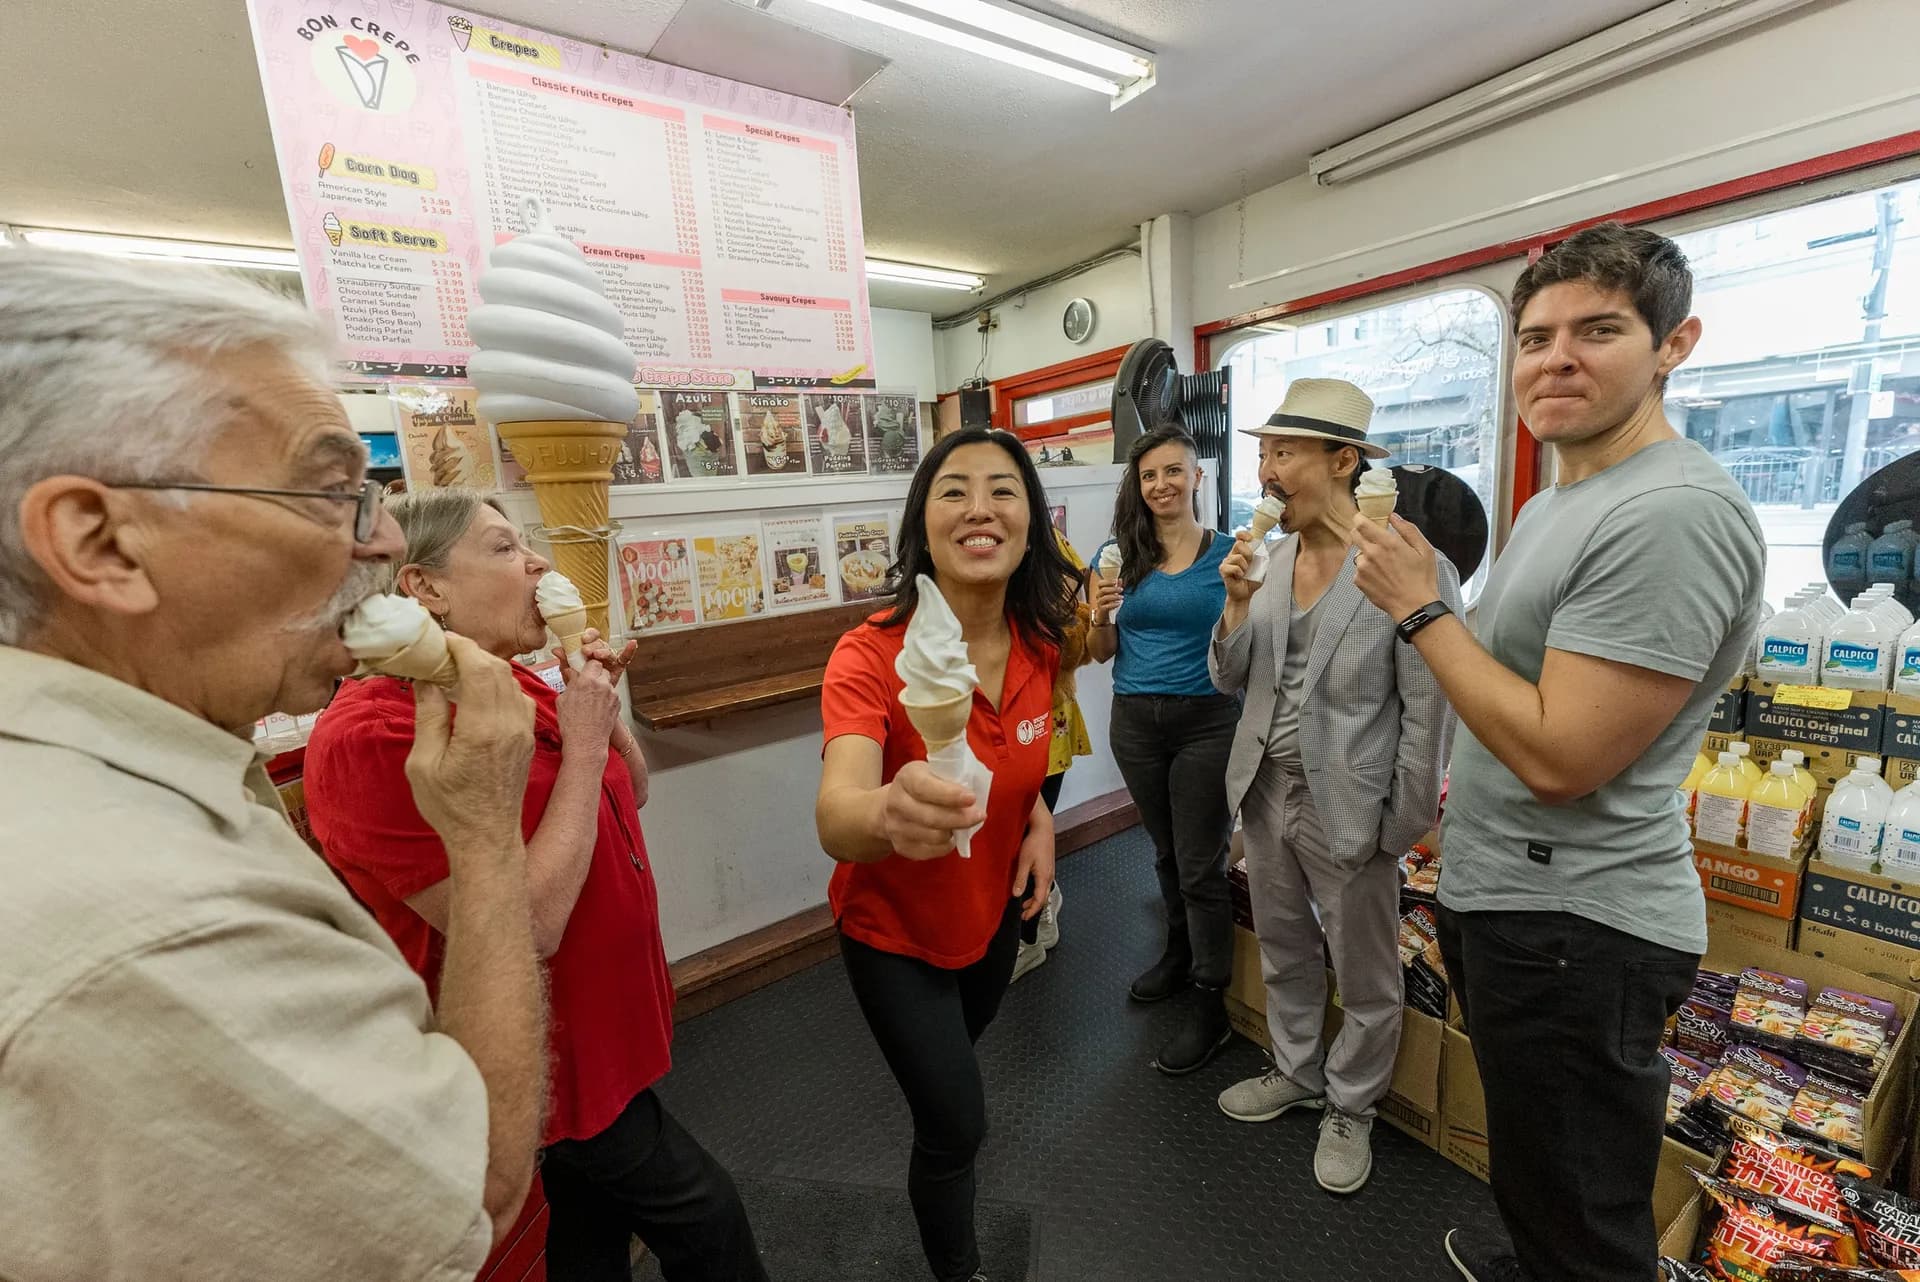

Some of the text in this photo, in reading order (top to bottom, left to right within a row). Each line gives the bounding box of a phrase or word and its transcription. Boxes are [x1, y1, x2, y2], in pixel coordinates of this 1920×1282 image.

[297, 14, 420, 65] BON CREPE
[489, 34, 540, 59] Crepes
[532, 76, 634, 107] Classic Fruits Crepes
[745, 124, 800, 143] Special Crepes
[345, 158, 420, 184] Corn Dog
[319, 181, 388, 198] American Style
[501, 182, 543, 196] Strawberry
[562, 192, 582, 202] Whip
[589, 196, 616, 206] Custard
[321, 192, 388, 207] Japanese Style
[421, 196, 450, 206] $ 3.99
[431, 207, 452, 216] 3.99
[351, 226, 438, 248] Soft Serve
[331, 249, 408, 263] Vanilla Ice Cream
[583, 245, 645, 260] Cream Crepes
[728, 253, 759, 264] Strawberry
[333, 258, 412, 273] Matcha Ice Cream
[336, 277, 421, 291] Strawberry Sundae
[338, 287, 417, 300] Chocolate Sundae
[760, 293, 816, 305] Savoury Crepes
[340, 296, 411, 308] Caramel Sundae
[342, 306, 416, 319] Azuki (Red Bean)
[448, 305, 468, 313] 5.99
[749, 306, 760, 314] Egg
[344, 315, 422, 328] Kinako (Soy Bean)
[346, 324, 413, 335] Pudding Parfait
[347, 333, 411, 344] Matcha Parfait
[424, 364, 462, 375] ソフト
[641, 368, 690, 387] Crepe
[691, 369, 735, 386] Store
[768, 377, 818, 385] コーンドッグ
[676, 393, 712, 403] Azuki
[750, 397, 789, 407] Kinako
[824, 455, 851, 463] Pudding
[826, 462, 852, 470] Parfait
[1767, 644, 1805, 655] CALPICO
[1833, 648, 1874, 661] CALPICO
[1760, 713, 1869, 737] CALPICO Original
[1783, 729, 1839, 744] 1.5 L (PET)
[1840, 818, 1859, 827] CALPICO
[1847, 885, 1920, 914] CALPICO
[1812, 906, 1830, 917] 1.5
[1833, 911, 1842, 921] L
[1861, 919, 1870, 929] 8
